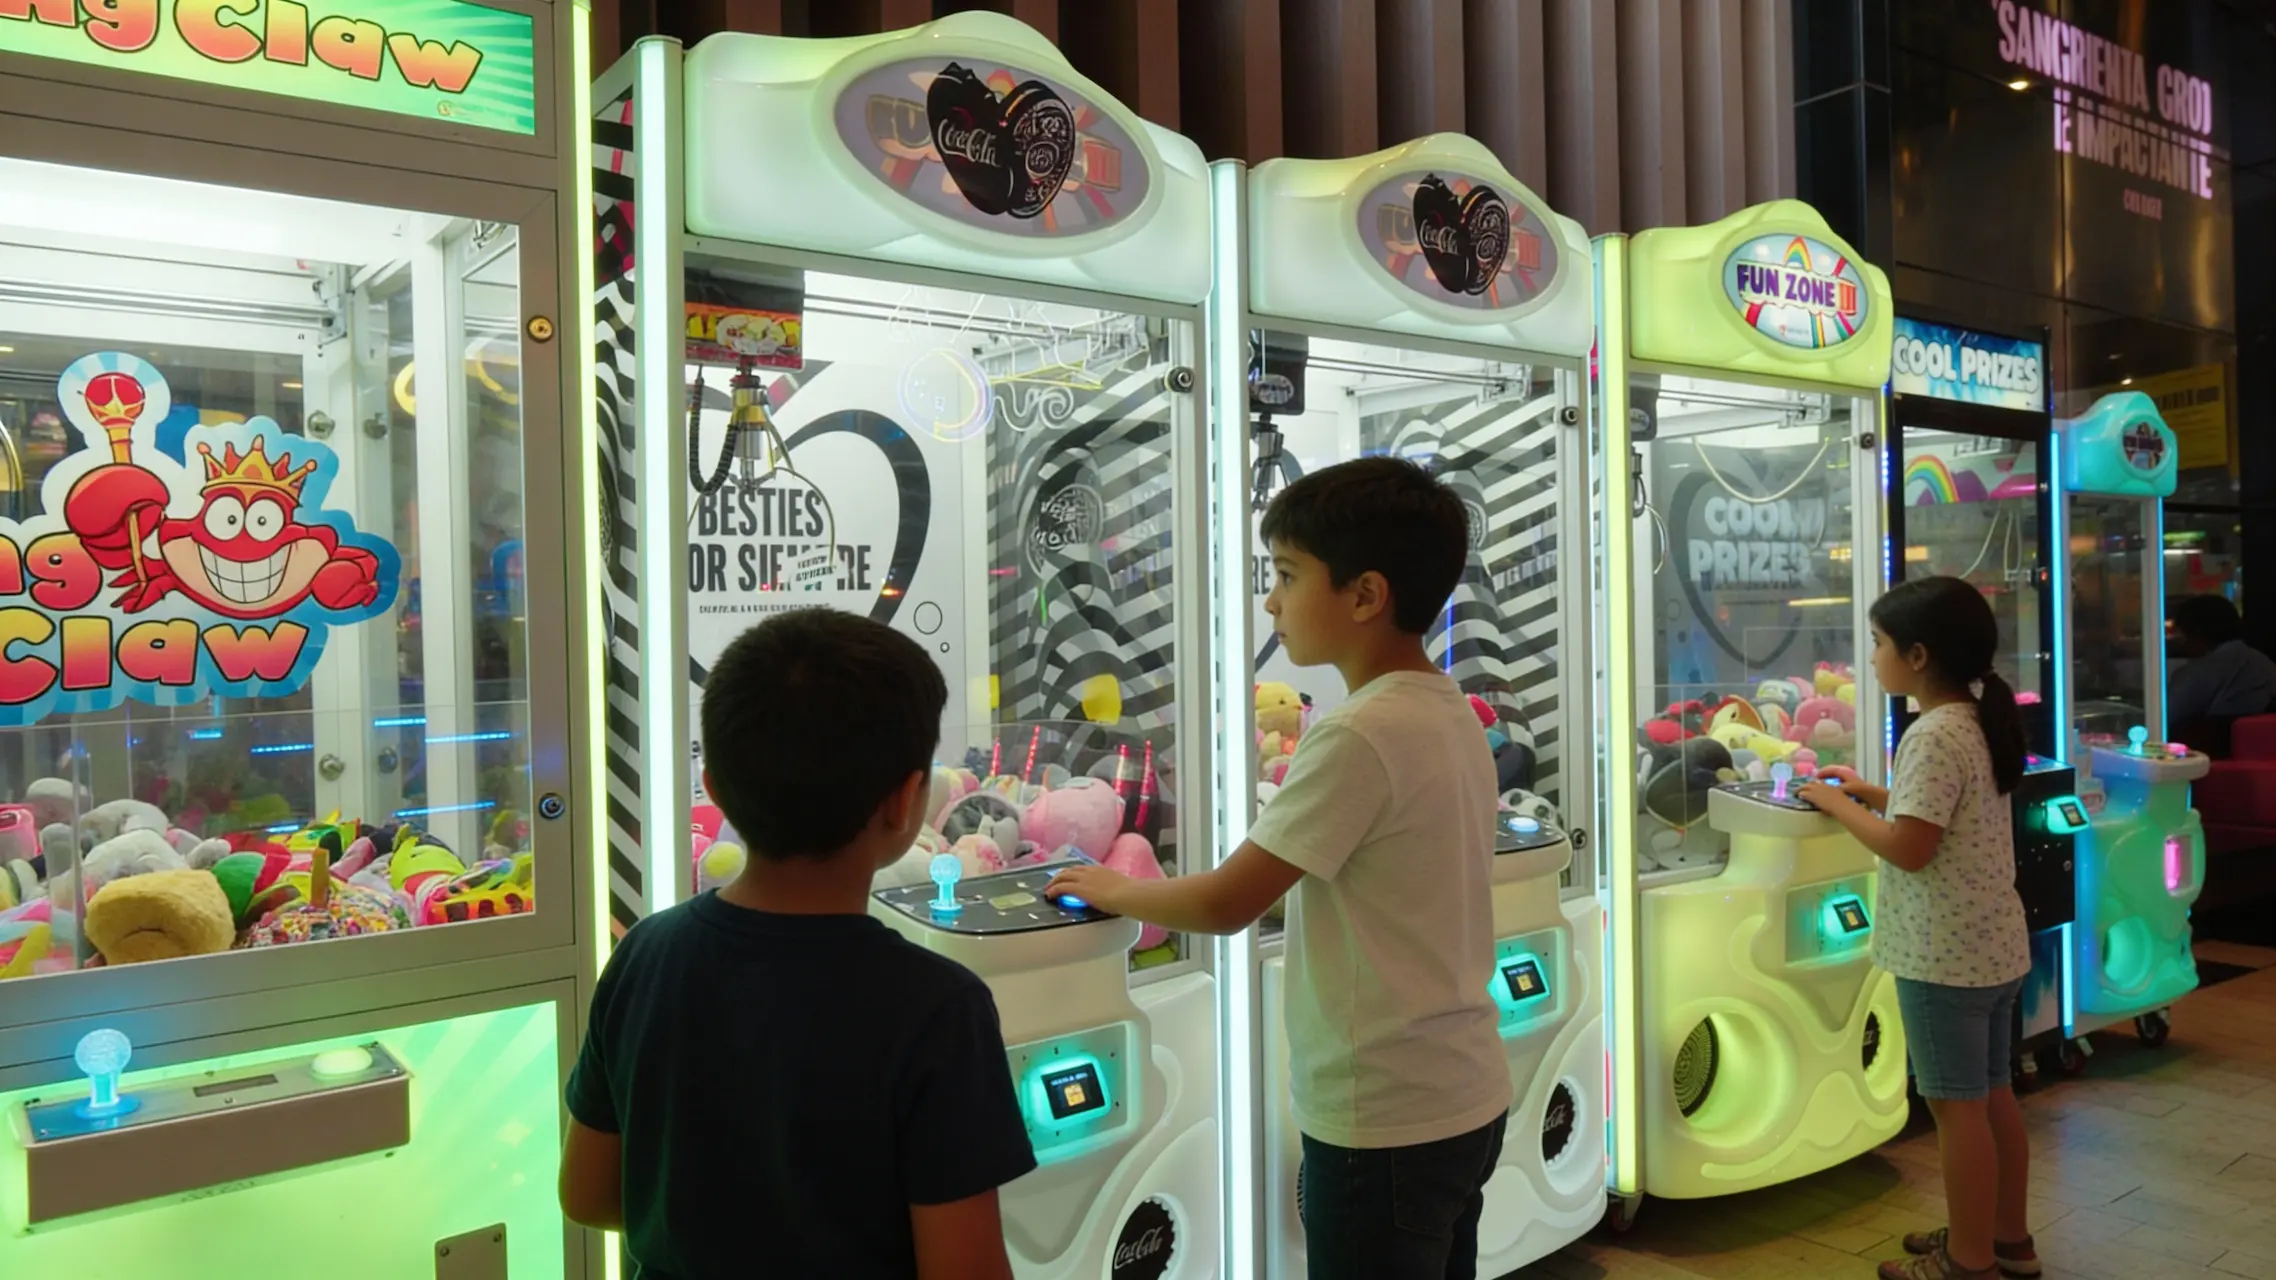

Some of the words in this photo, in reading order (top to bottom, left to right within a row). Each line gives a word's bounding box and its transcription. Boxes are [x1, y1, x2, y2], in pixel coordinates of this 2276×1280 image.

[174, 0, 483, 93] Claw
[1736, 263, 1779, 297] FUN
[1785, 273, 1836, 308] ZONE
[1893, 334, 1957, 383] COOL
[1960, 345, 2038, 394] PRIZES
[698, 486, 824, 537] BESTIES
[738, 543, 872, 592] SIERE
[0, 606, 308, 705] Claw
